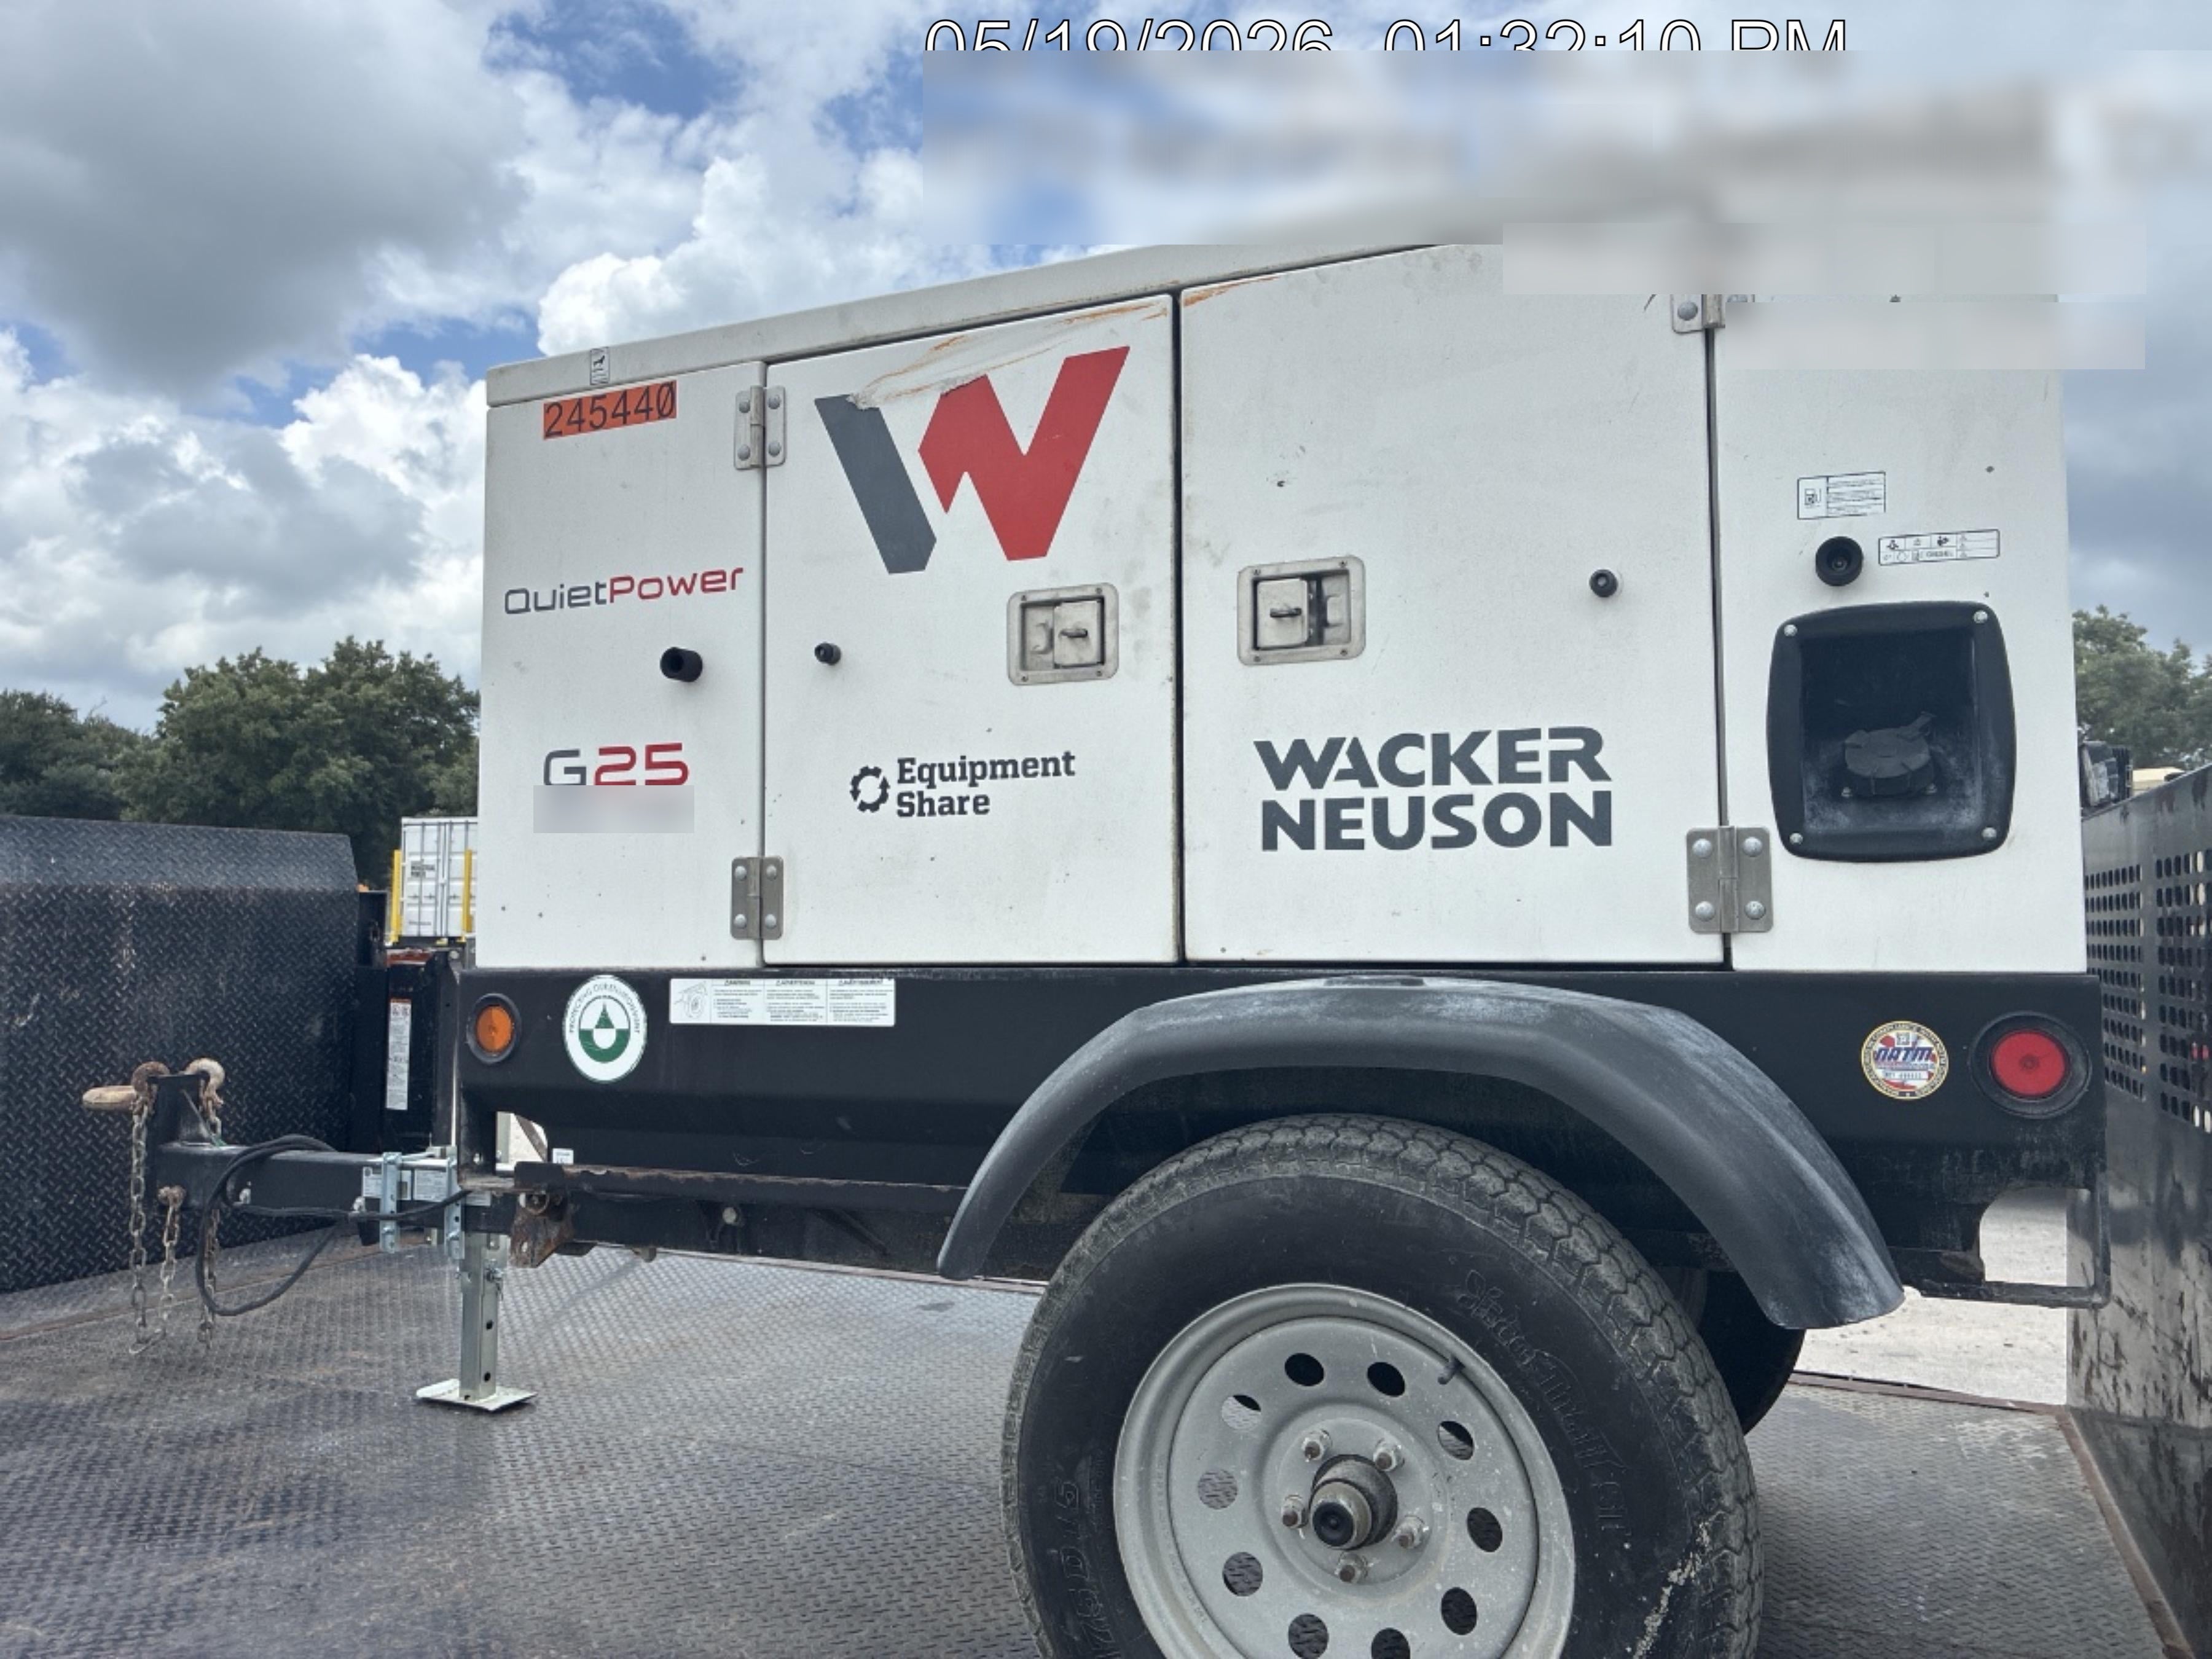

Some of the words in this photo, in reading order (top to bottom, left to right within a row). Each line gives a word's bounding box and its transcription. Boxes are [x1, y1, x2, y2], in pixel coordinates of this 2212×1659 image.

[545, 382, 675, 437] 245440
[504, 567, 743, 614] QuietPower
[543, 742, 689, 786] G25
[896, 750, 1076, 788] Equipment
[1253, 726, 1612, 791] WACKER
[896, 791, 990, 817] Share
[1262, 790, 1612, 852] NEUSON
